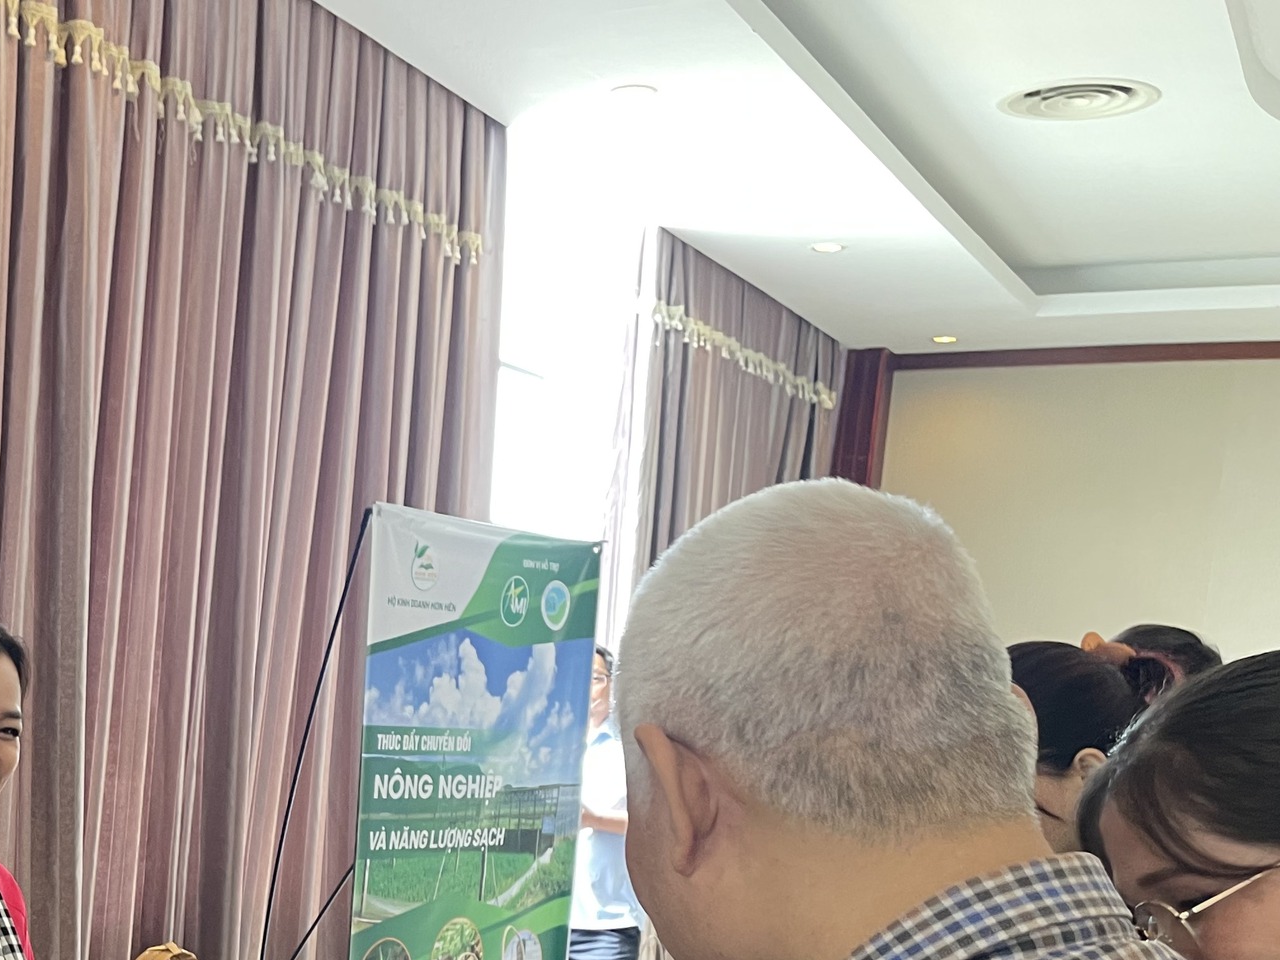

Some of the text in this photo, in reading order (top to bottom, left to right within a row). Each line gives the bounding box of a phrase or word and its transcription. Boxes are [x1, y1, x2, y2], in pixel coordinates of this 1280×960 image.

[377, 728, 472, 752] THÚC ĐẨY CHUYỂN ĐỔI
[373, 767, 503, 806] NÔNG NGHIỆP
[369, 826, 506, 853] VÀ NĂNG LƯỢNG SẠCH
